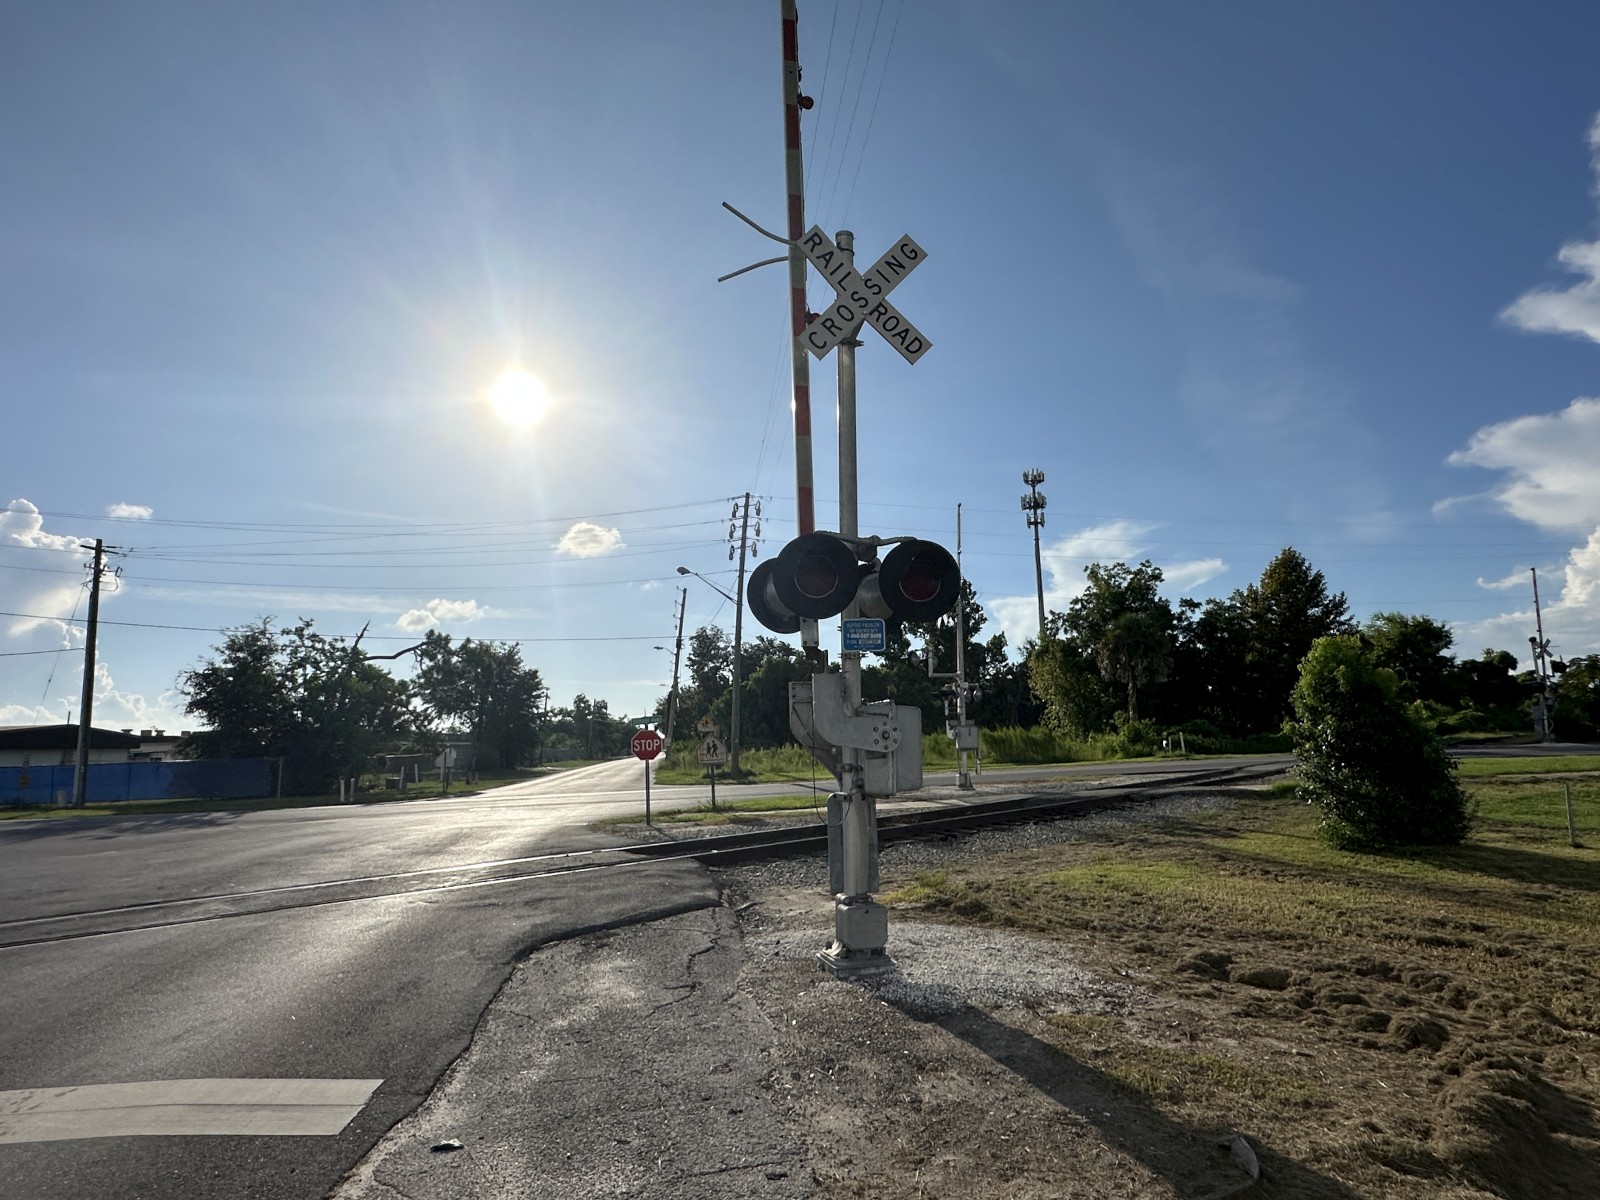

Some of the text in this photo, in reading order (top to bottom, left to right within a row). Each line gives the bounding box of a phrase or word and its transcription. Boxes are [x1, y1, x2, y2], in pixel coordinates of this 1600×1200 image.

[803, 231, 923, 355] RAIL ROAD
[808, 243, 919, 350] CROSSING
[633, 739, 661, 752] STOP
